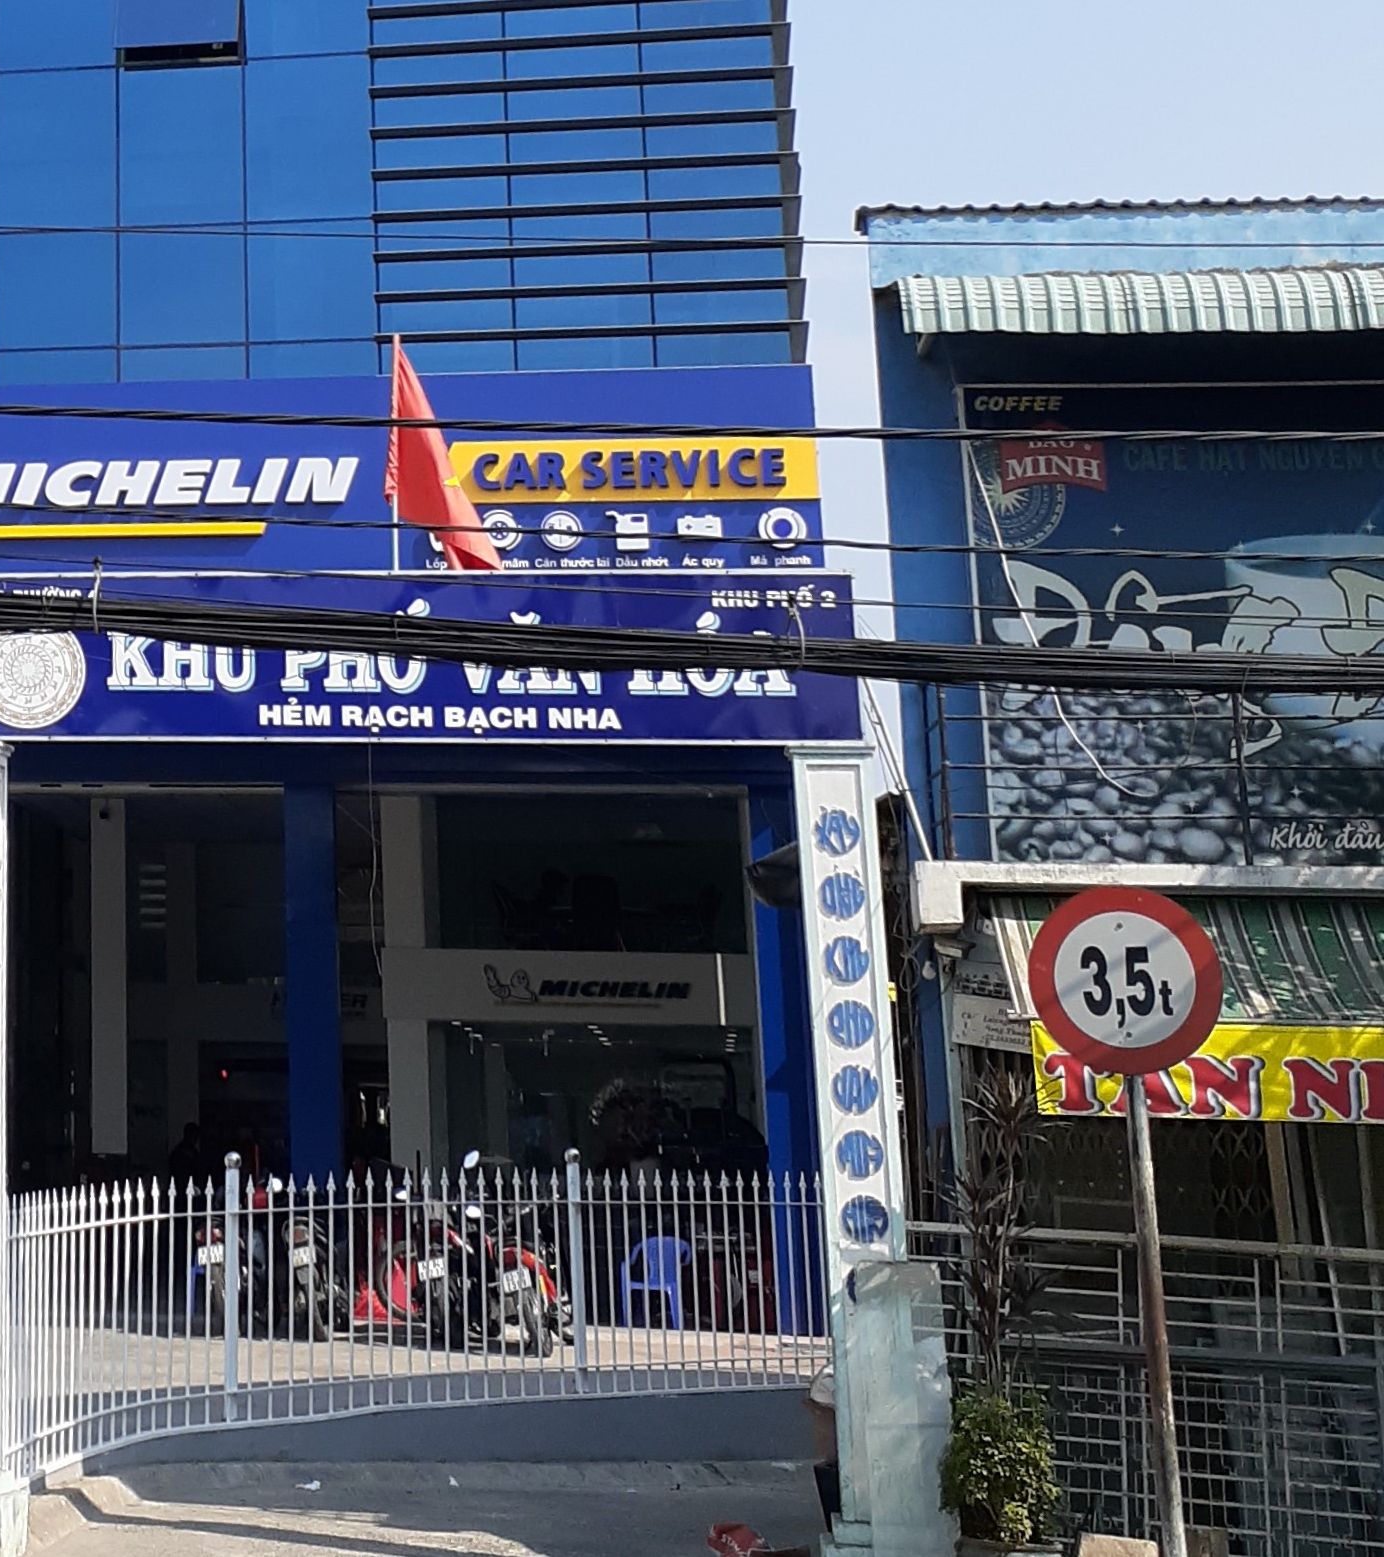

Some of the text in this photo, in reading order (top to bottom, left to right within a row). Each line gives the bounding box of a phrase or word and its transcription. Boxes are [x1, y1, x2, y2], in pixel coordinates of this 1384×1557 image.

[974, 394, 1064, 412] COFFEE
[472, 447, 787, 490] CAR SERVICE
[1005, 454, 1102, 482] MINH
[534, 557, 557, 568] Cân
[560, 556, 594, 568] thước
[641, 556, 668, 567] nhớt
[701, 557, 725, 569] quy
[774, 555, 812, 568] phanh
[711, 584, 837, 608] KHU PHỐ 2
[107, 631, 256, 693] KHU
[258, 697, 623, 734] HẺM RẠCH BẠCH NHA
[1270, 821, 1384, 849] Khởi đầu
[538, 979, 692, 999] MICHELIN
